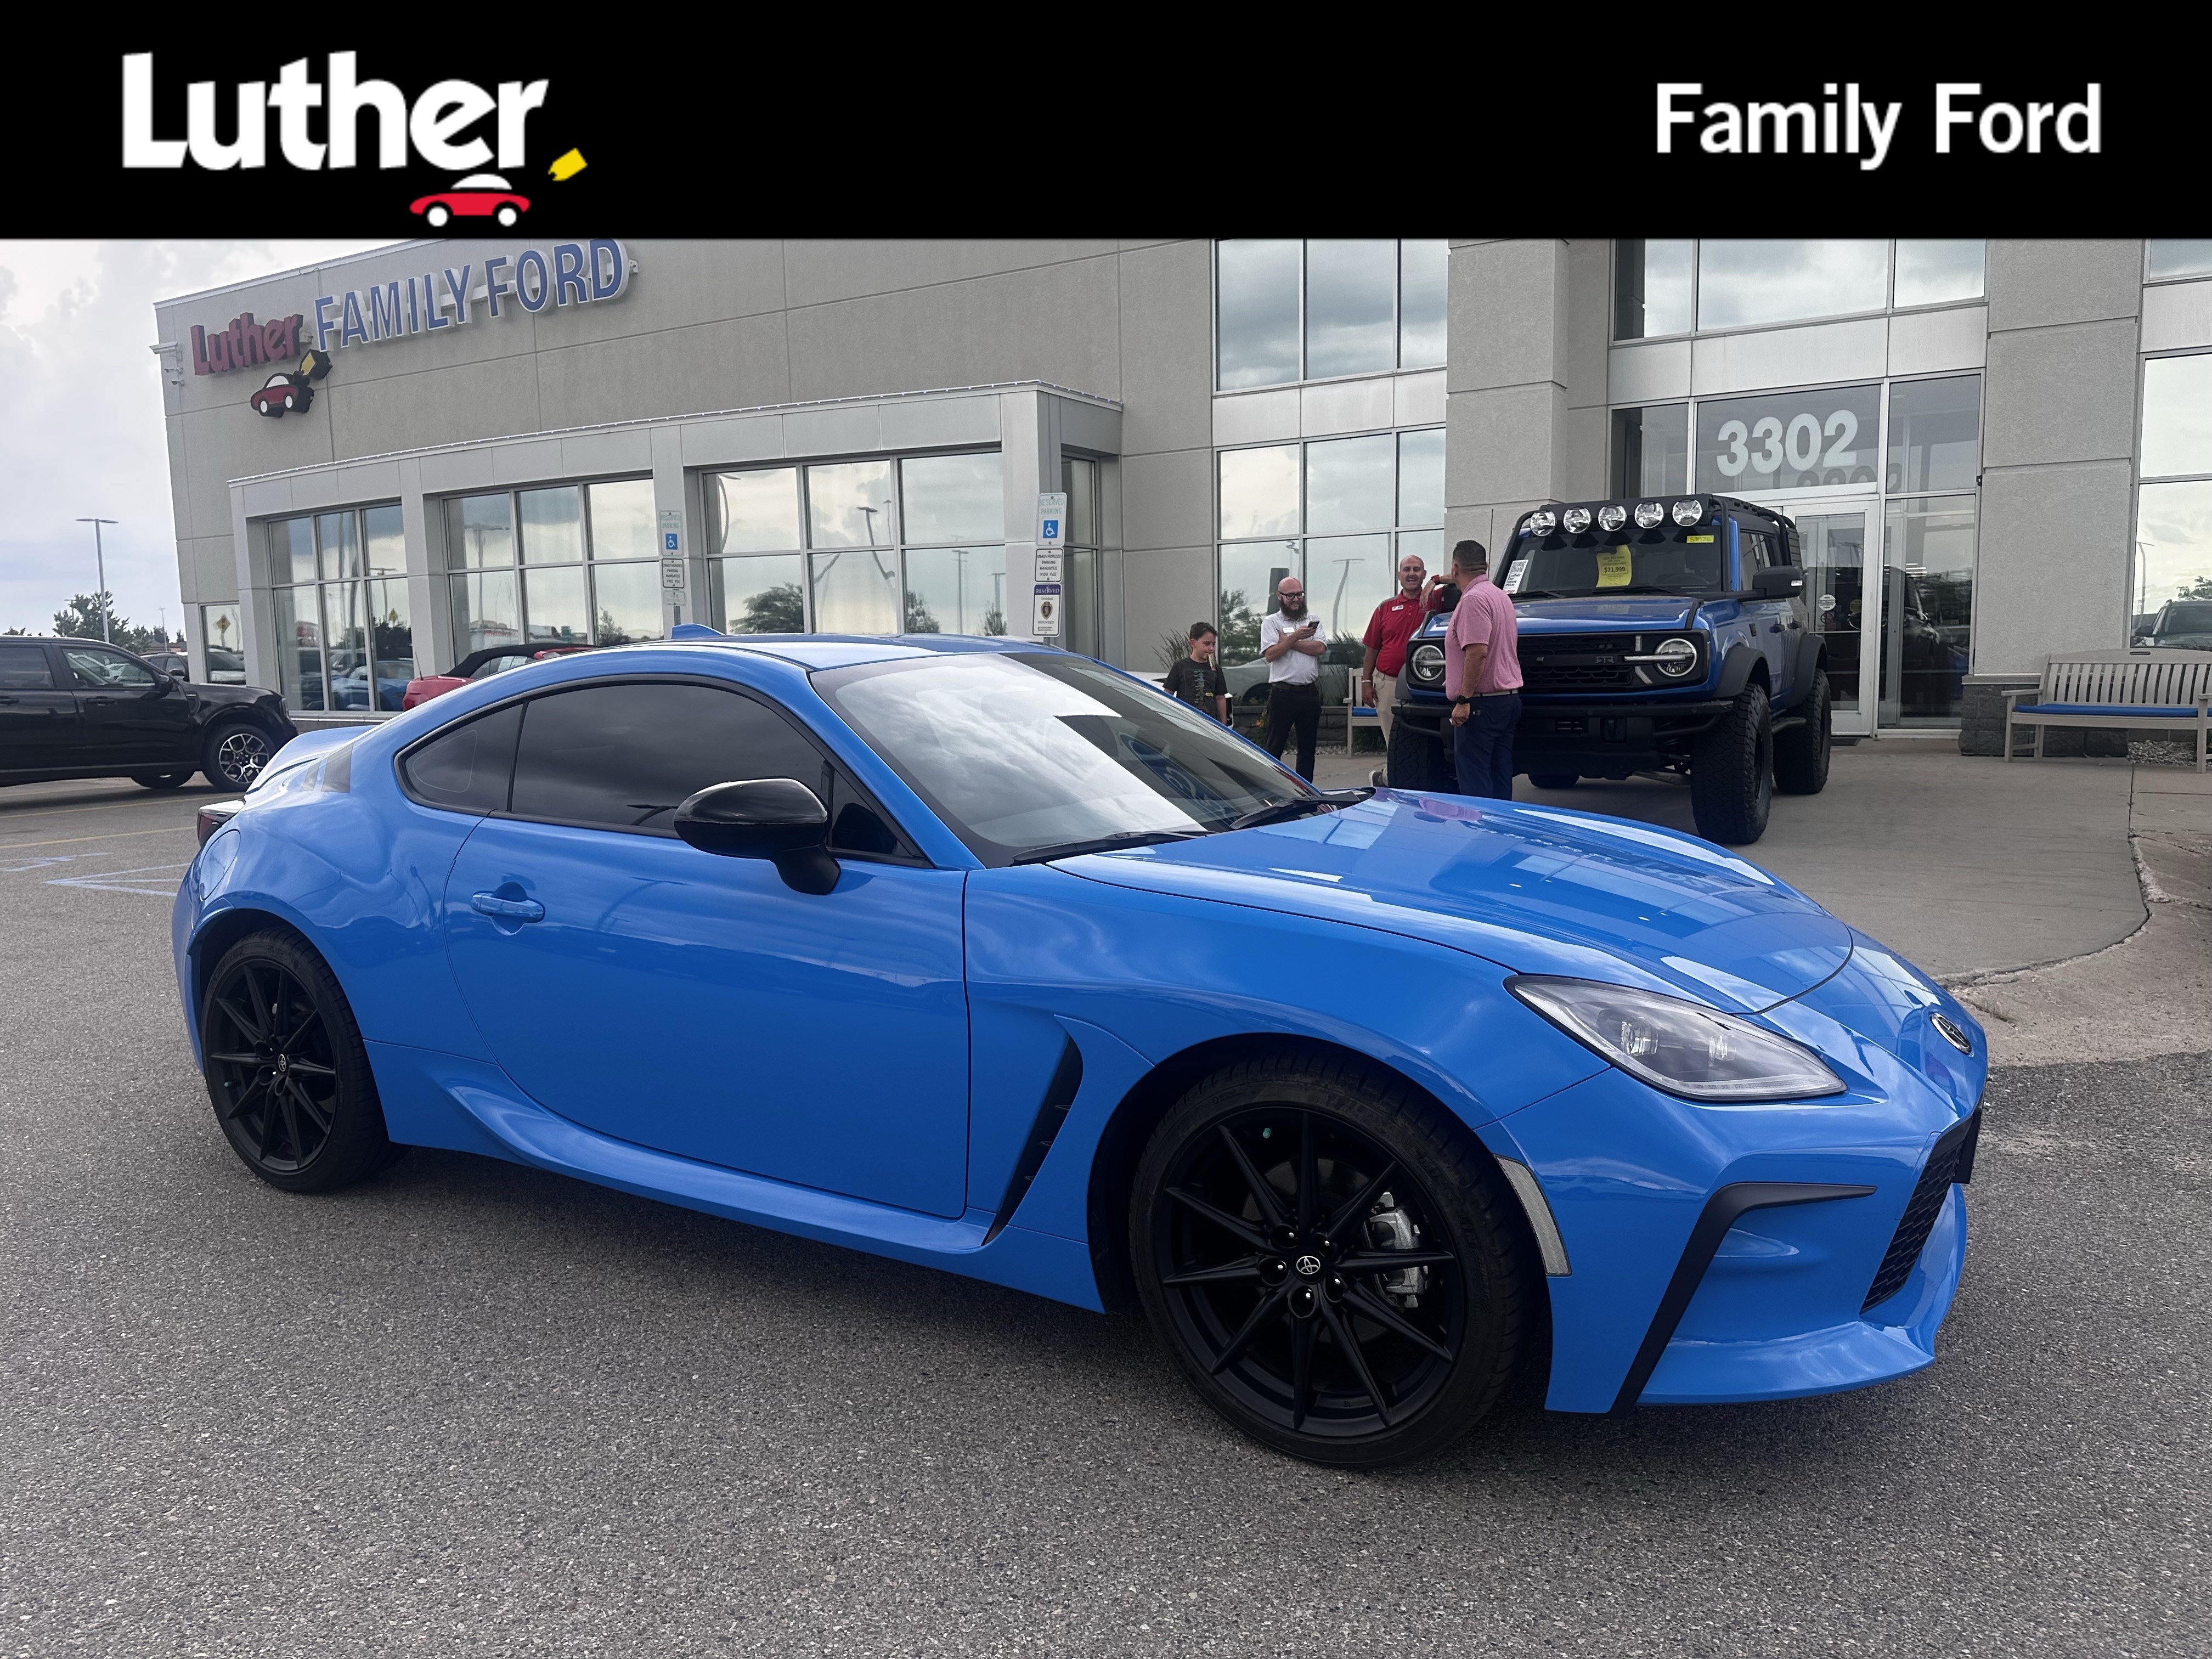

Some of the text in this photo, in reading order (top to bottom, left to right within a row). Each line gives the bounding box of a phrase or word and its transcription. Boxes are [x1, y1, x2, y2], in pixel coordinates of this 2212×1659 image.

[314, 238, 629, 352] FAMILY FORD
[190, 312, 303, 376] Luther
[1717, 410, 1858, 476] 3302
